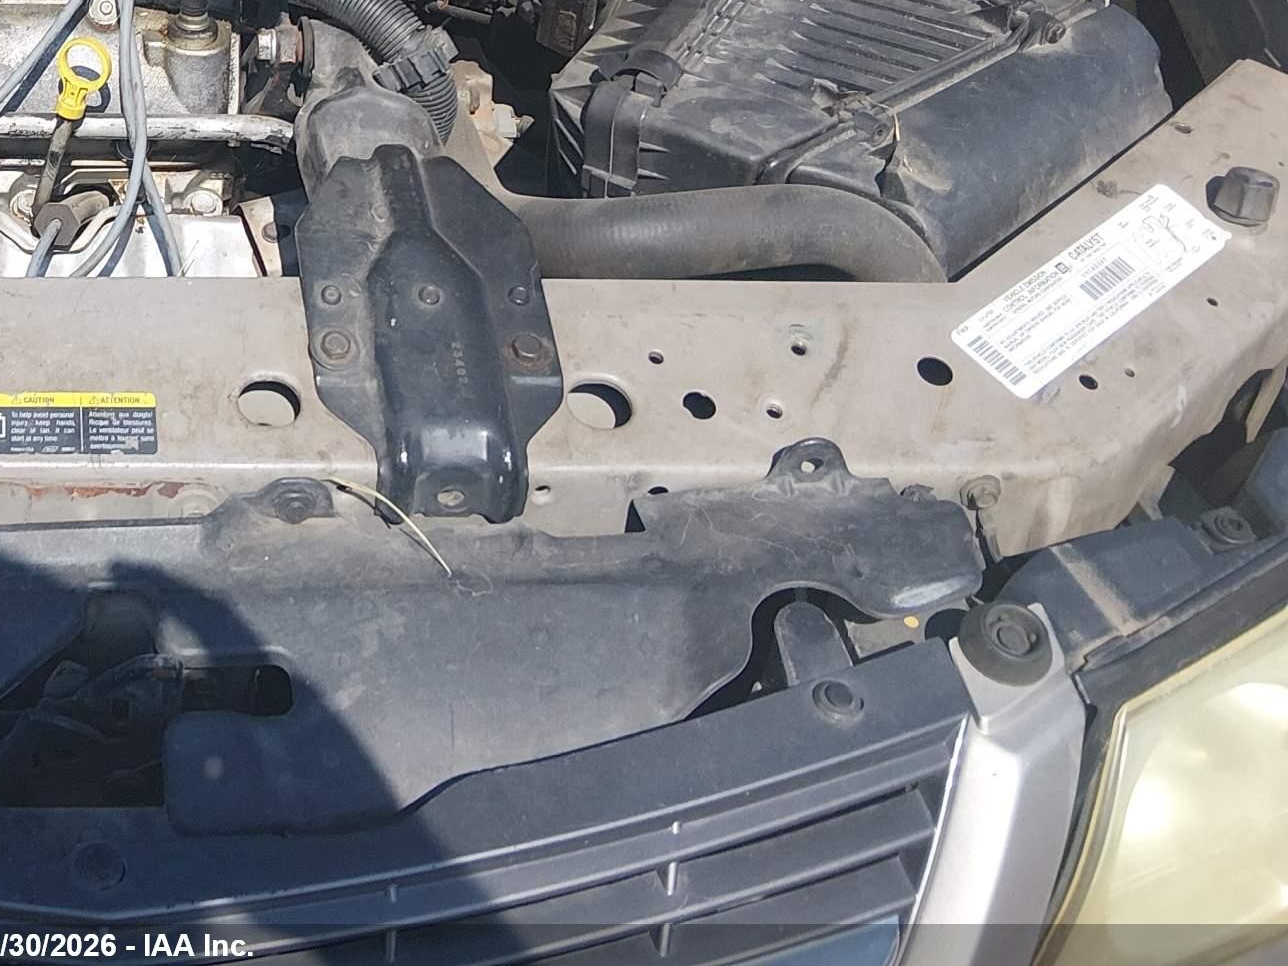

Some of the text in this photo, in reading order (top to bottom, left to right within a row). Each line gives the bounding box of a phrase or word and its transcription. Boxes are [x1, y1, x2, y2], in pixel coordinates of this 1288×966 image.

[1068, 232, 1104, 261] CATALYST
[100, 396, 140, 404] ATTENTION
[50, 411, 75, 419] personal
